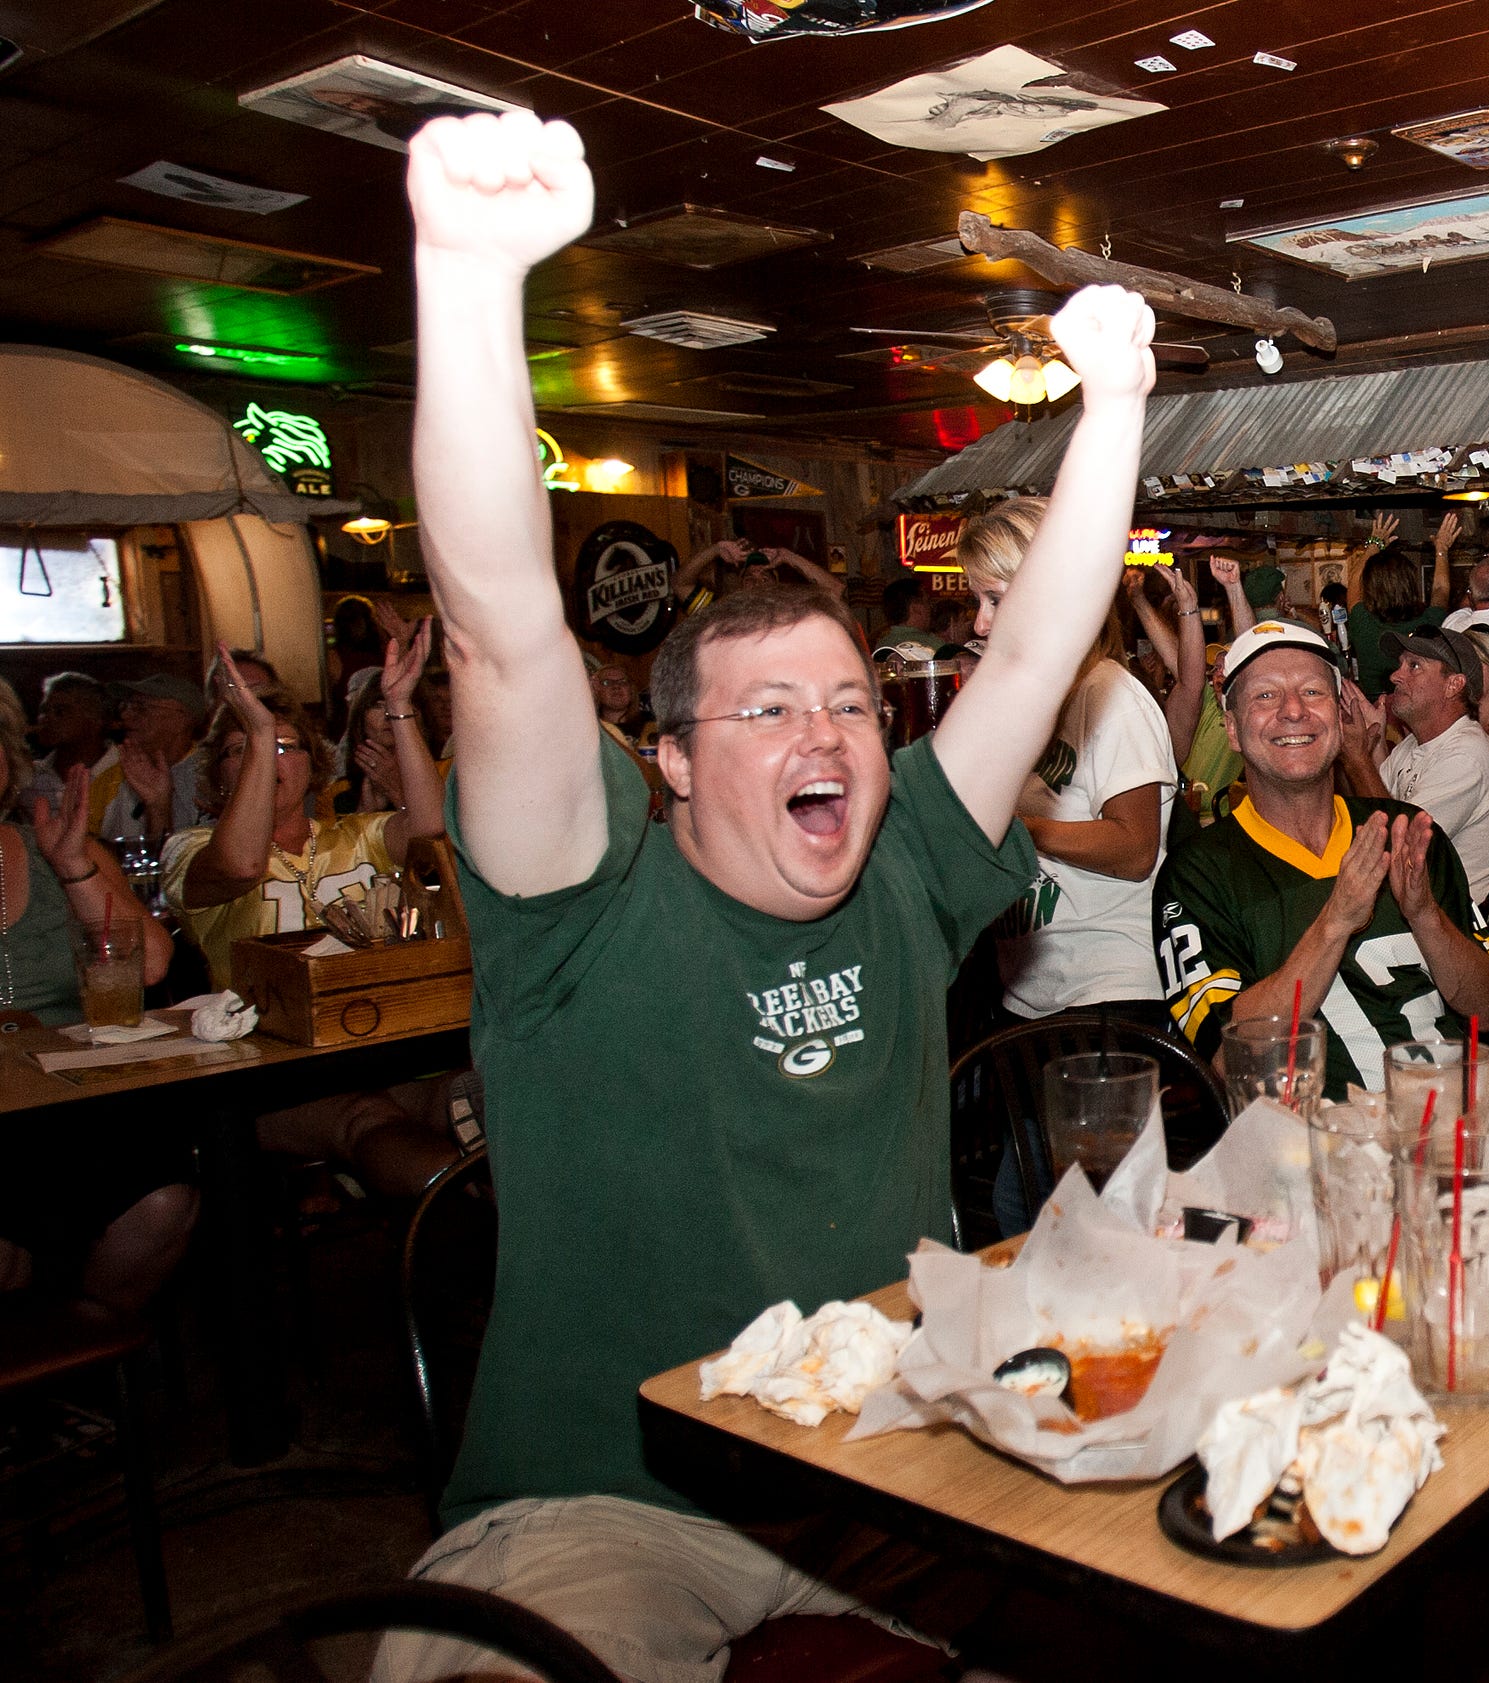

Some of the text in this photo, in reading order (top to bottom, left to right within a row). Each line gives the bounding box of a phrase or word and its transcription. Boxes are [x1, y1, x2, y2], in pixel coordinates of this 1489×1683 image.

[295, 483, 332, 496] ALE
[728, 469, 785, 490] CHAMPIONS
[931, 573, 969, 591] BEE
[1159, 923, 1213, 1000] 12
[809, 965, 864, 1004] BAY
[782, 1038, 833, 1076] G
